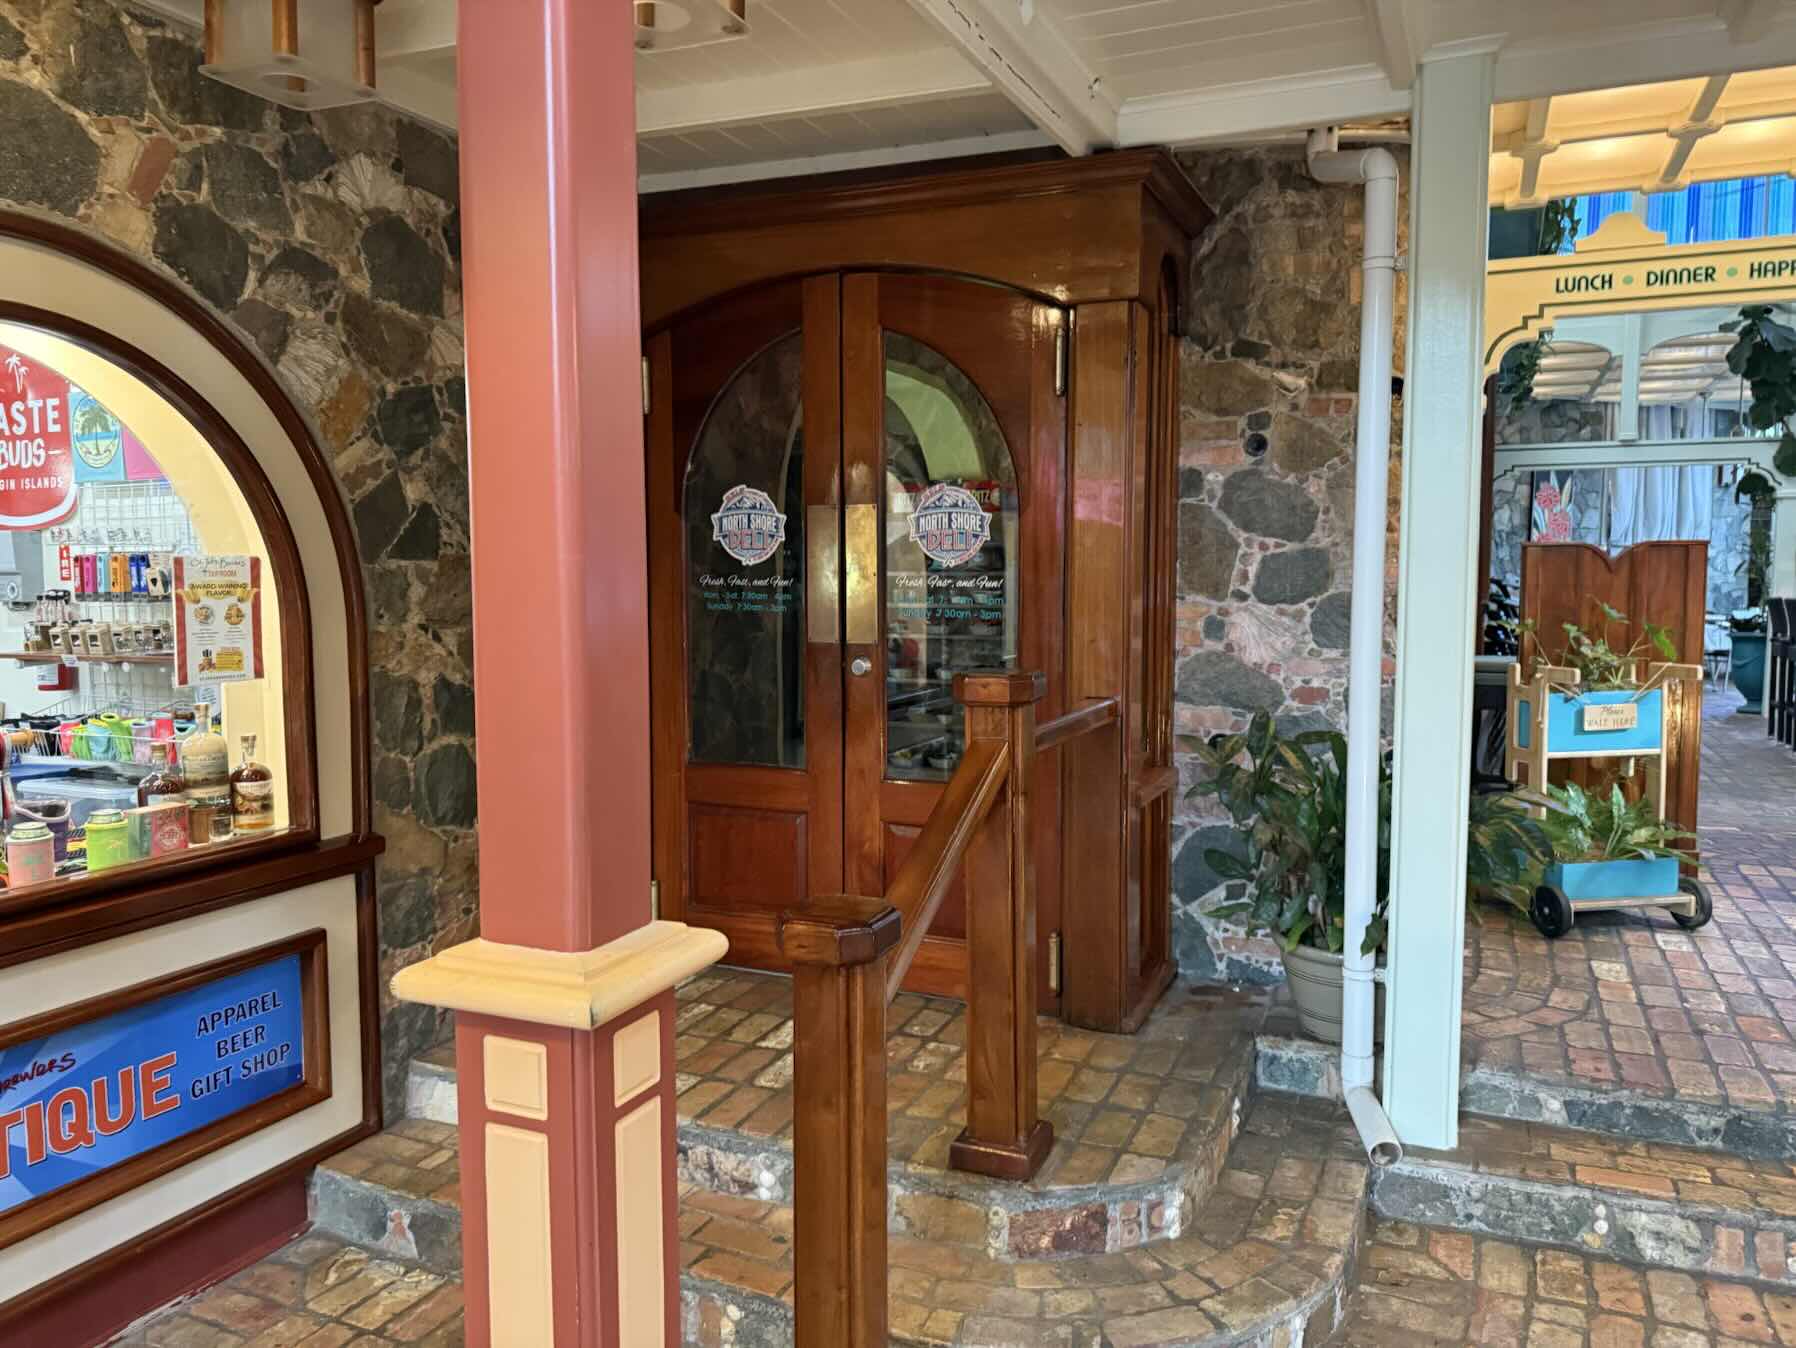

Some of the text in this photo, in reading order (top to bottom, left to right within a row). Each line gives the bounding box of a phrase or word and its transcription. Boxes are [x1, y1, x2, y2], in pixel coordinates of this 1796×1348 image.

[1555, 273, 1613, 294] LUNCH
[1646, 266, 1716, 287] DINNER
[21, 476, 64, 490] ISLANDS
[722, 513, 777, 532] NORTH SHORE
[919, 512, 982, 532] NORTH SHORE
[728, 528, 769, 550] DELI
[927, 528, 972, 551] DELI
[956, 578, 975, 588] and
[975, 575, 1004, 589] Fun!
[196, 991, 282, 1038] APPAREL
[216, 1024, 266, 1059] BEER
[191, 1042, 291, 1099] GIFT SHOP
